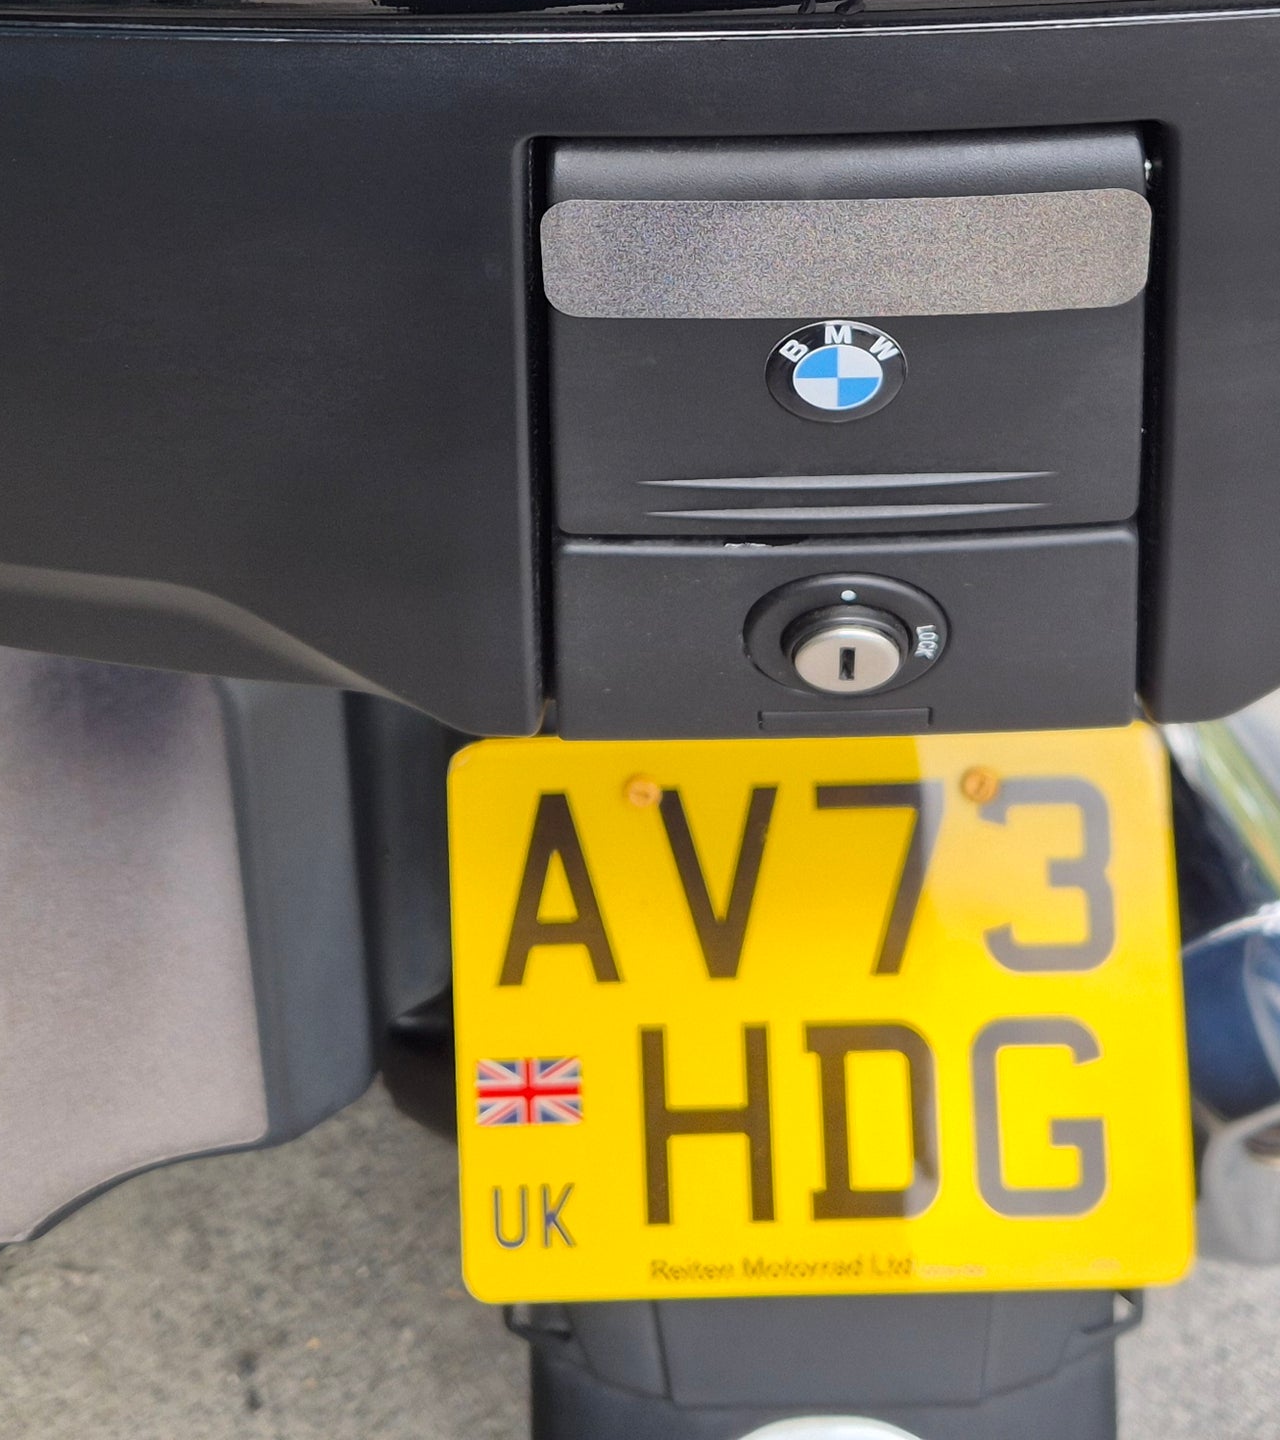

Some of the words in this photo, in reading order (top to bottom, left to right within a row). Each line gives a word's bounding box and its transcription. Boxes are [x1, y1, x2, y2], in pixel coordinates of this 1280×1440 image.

[779, 324, 900, 363] BMW
[914, 624, 939, 660] LOCK
[496, 774, 1117, 987] AV73
[638, 1015, 1109, 1227] HDG
[492, 1182, 577, 1250] UK
[650, 1258, 735, 1281] Reiten
[741, 1254, 864, 1280] Motorrad
[870, 1252, 914, 1278] Ltd
